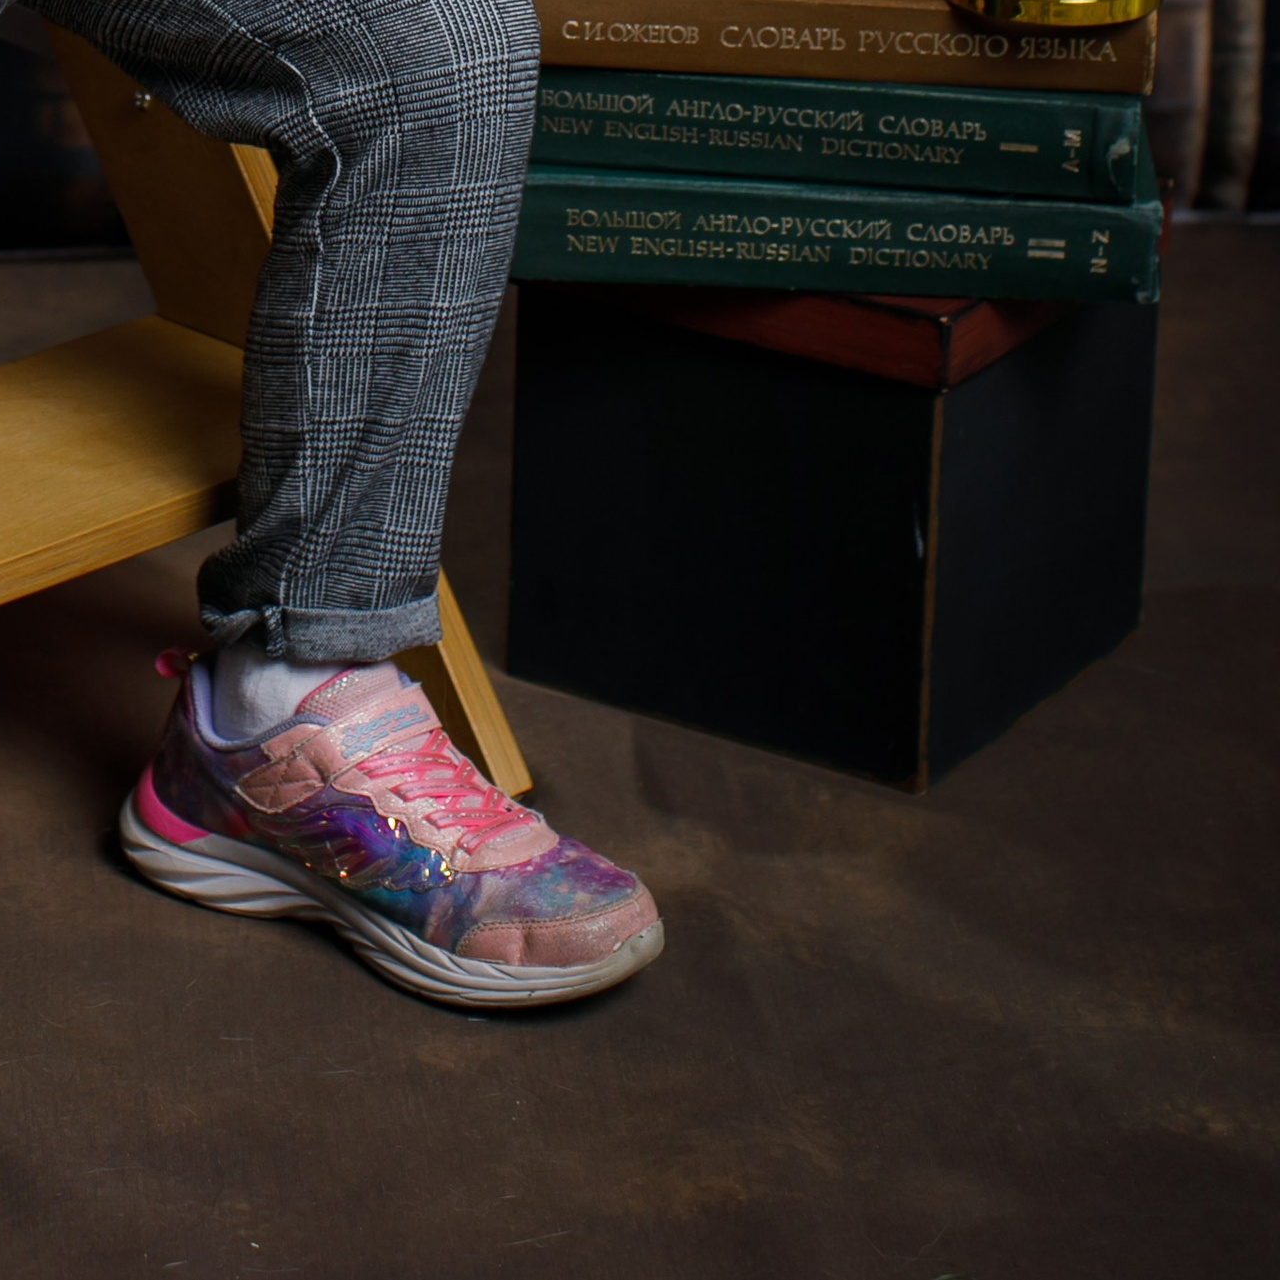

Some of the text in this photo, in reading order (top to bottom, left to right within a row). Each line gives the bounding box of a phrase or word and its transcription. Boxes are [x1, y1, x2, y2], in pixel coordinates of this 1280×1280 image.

[720, 25, 847, 51] СЛОВАРЬ
[858, 30, 1008, 58] РУССКОГО
[1017, 36, 1118, 62] ЯЗЫКА
[541, 89, 987, 141] БОЛЬШОЙ АНГЛО-РУССКИЙ СЛОВАРЬ
[542, 116, 965, 165] NEW ENGLISH-RUSSIAN DICTIONARY
[566, 208, 1015, 246] БОЛЬШОЙ АНГЛО-РУССКИЙ СЛОВАРЬ
[567, 235, 992, 271] NEW ENGLISH-RUSSIAN DICTIONARY
